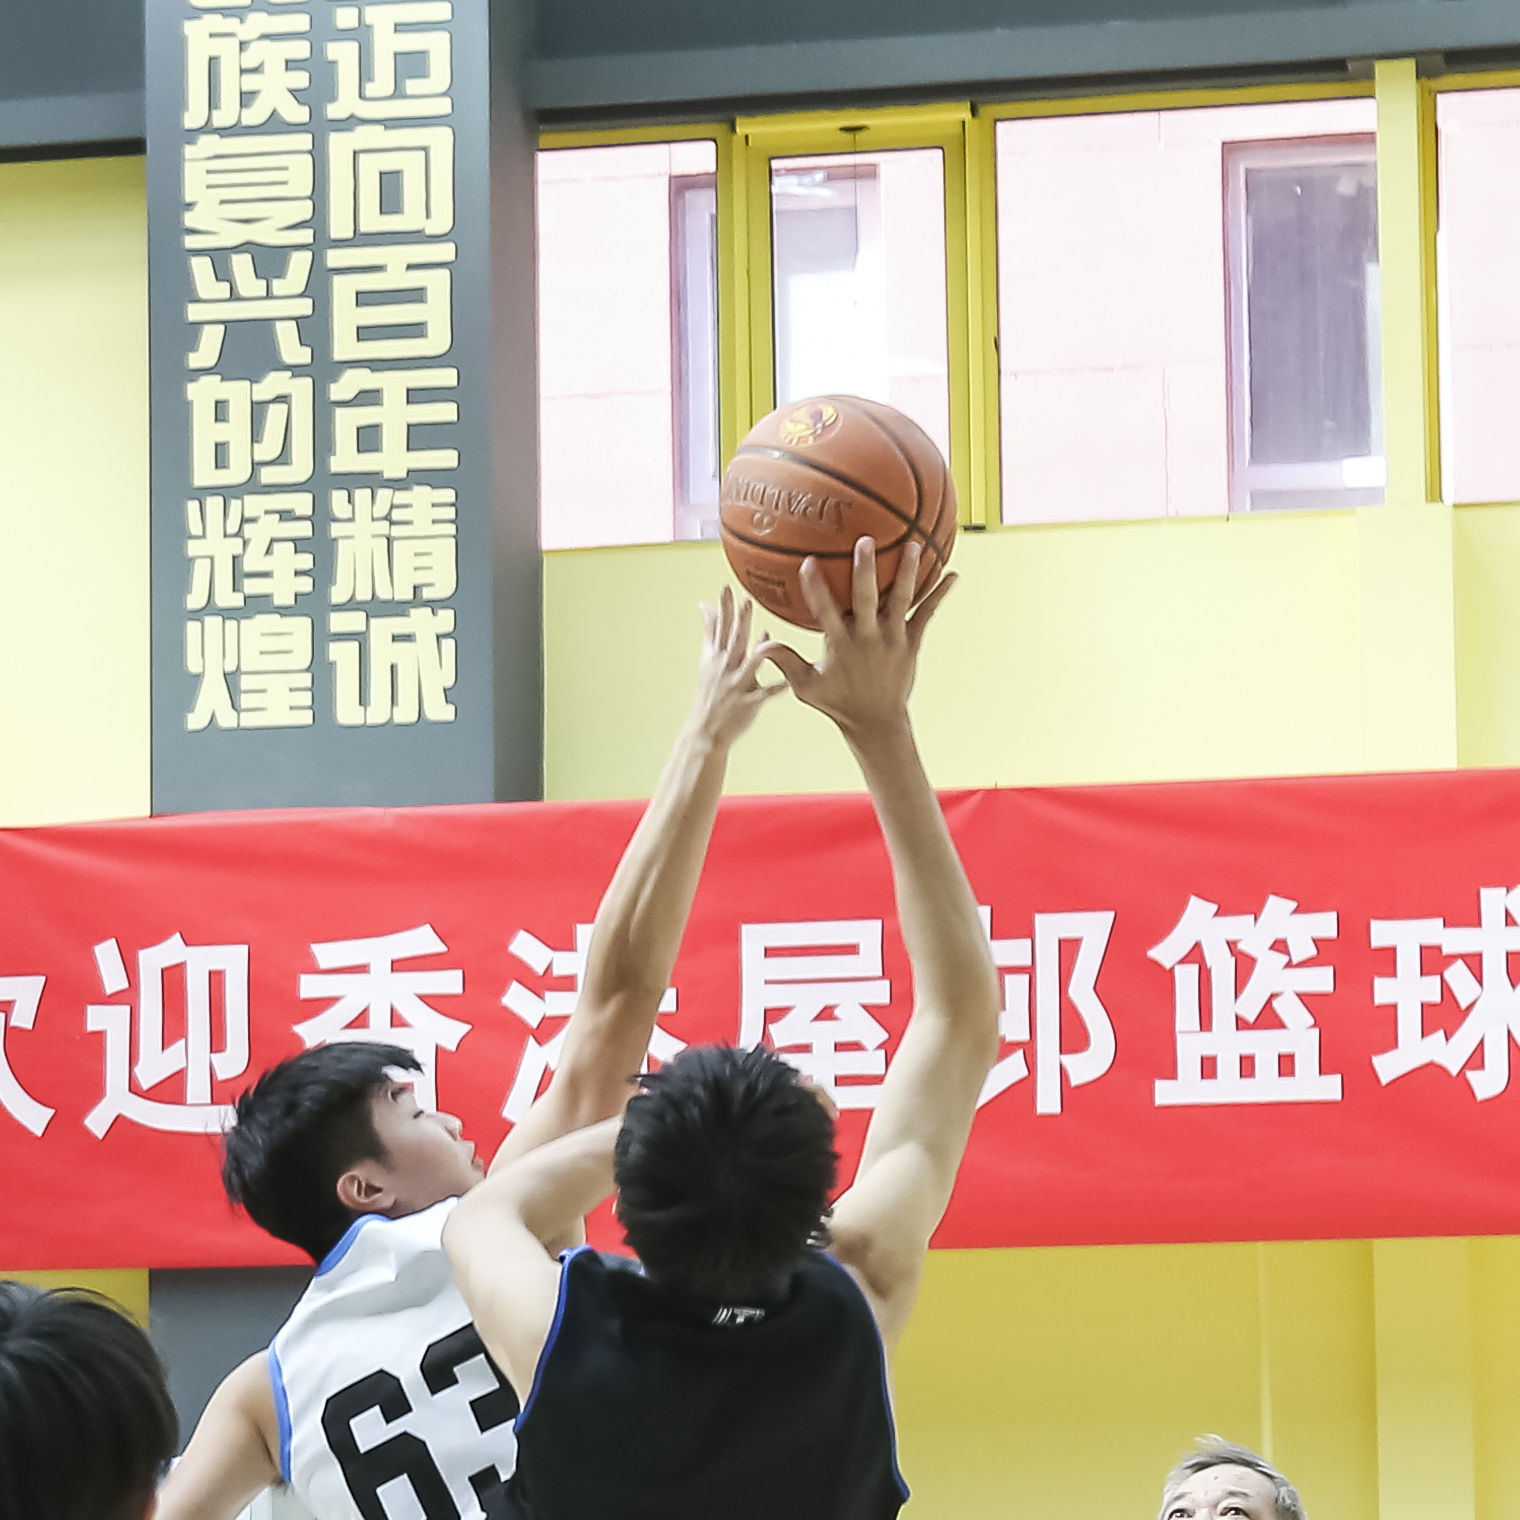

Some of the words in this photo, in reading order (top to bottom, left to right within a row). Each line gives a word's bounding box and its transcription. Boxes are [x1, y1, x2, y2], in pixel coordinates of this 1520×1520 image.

[183, 0, 316, 731] 族复兴的辉煌
[325, 1, 460, 726] 迈向百年精诚
